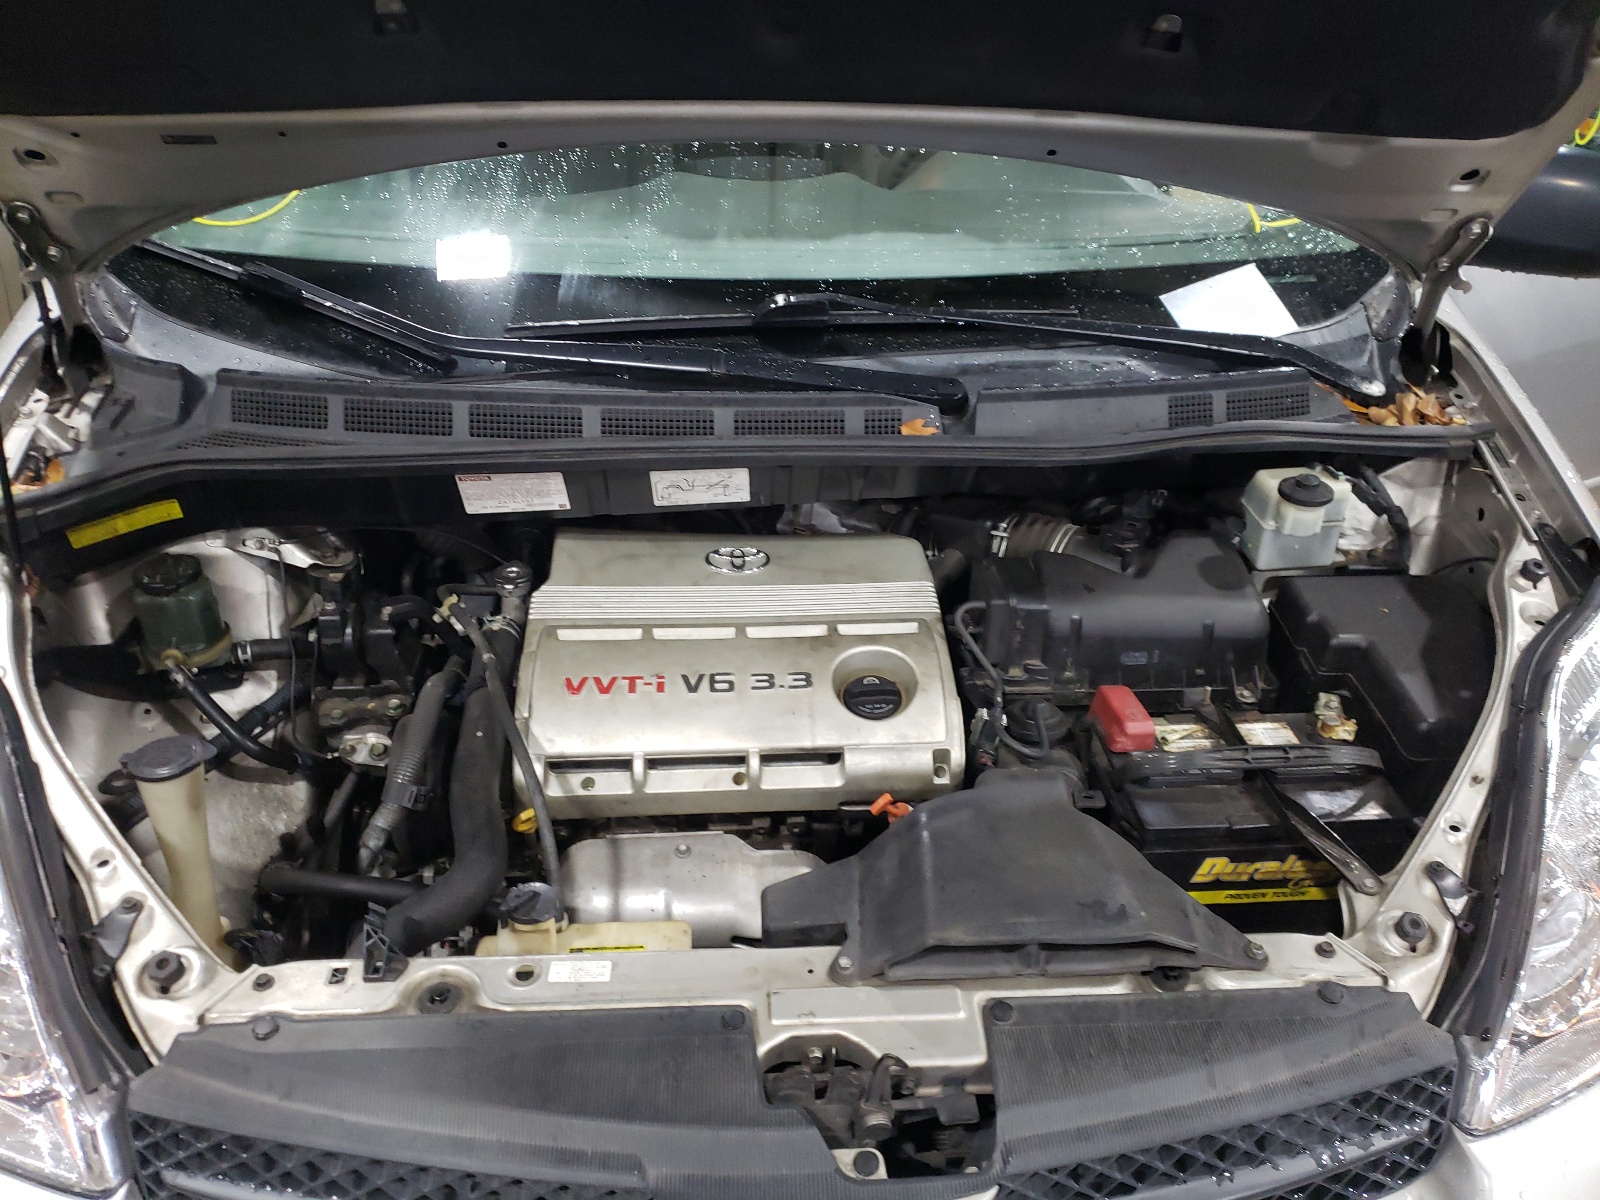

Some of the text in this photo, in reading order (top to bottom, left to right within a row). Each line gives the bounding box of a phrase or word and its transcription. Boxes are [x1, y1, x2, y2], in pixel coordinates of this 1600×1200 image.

[564, 671, 814, 695] VVT-i V6 3.3
[1189, 854, 1339, 883] Durala
